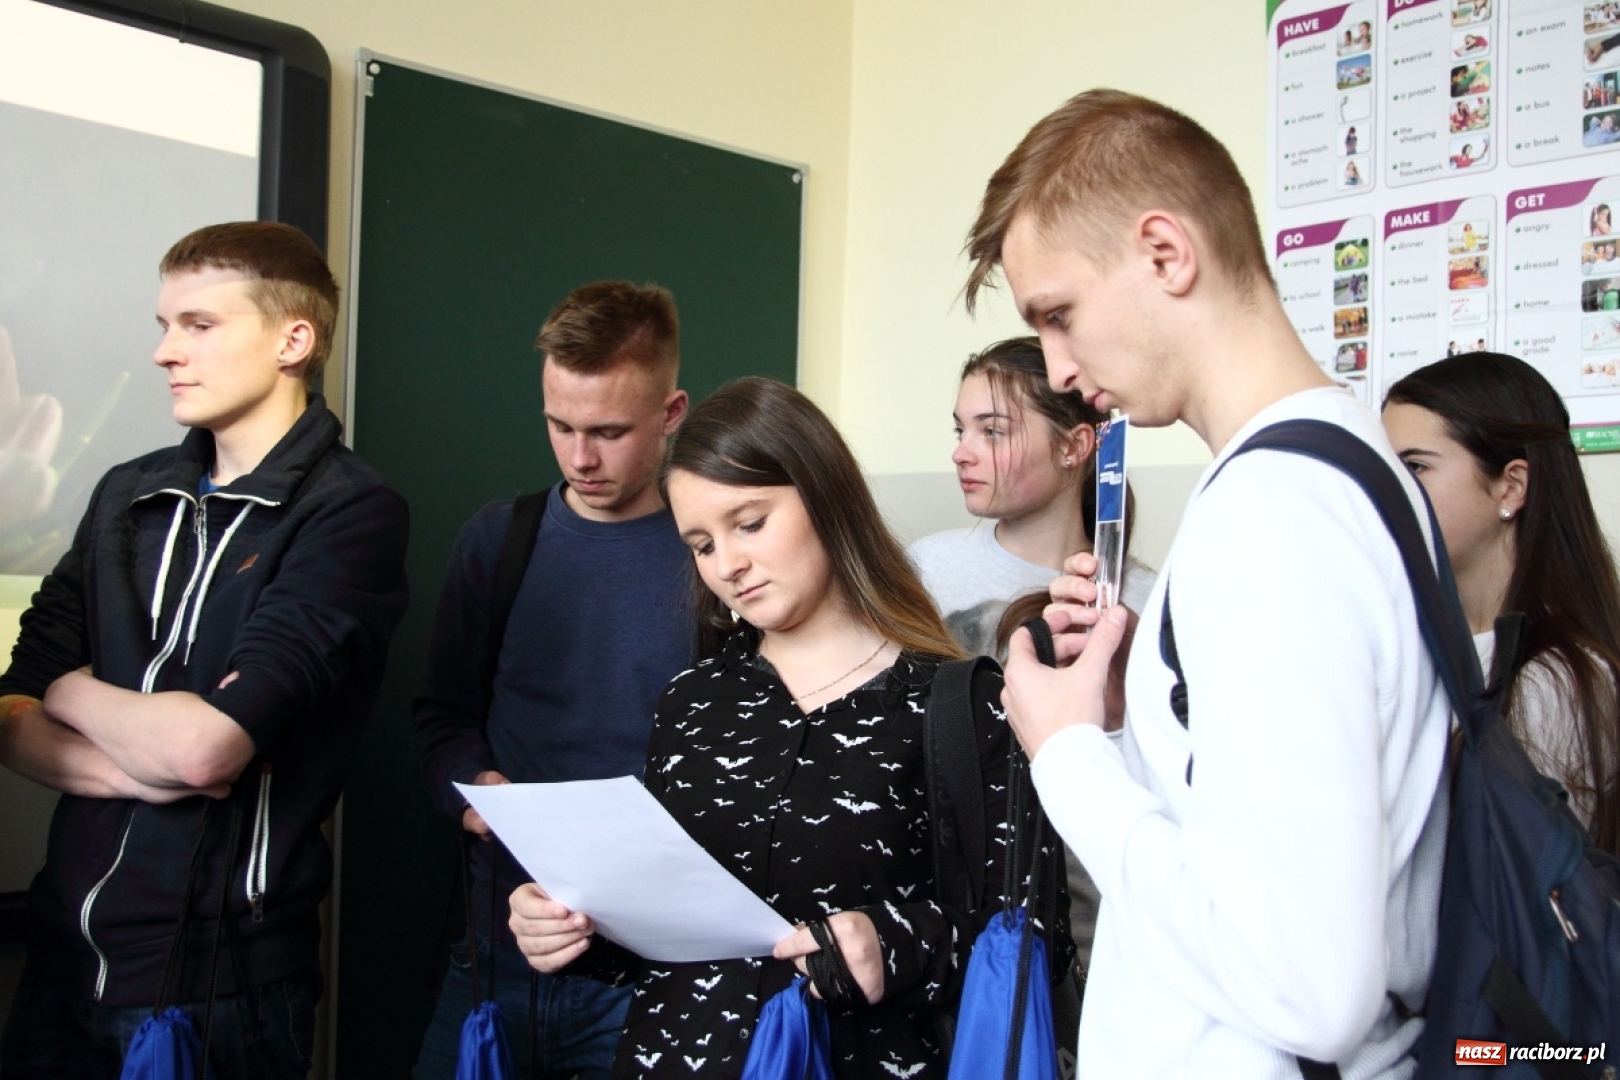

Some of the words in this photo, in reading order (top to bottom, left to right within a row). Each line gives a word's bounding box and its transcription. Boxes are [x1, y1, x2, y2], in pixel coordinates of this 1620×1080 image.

[1401, 11, 1443, 27] homework
[1284, 18, 1320, 37] HAVE
[1525, 27, 1538, 36] an
[1540, 21, 1567, 32] exam
[1401, 51, 1433, 63] exercise
[1525, 63, 1551, 73] notes
[1408, 85, 1436, 100] project
[1534, 100, 1551, 110] bus
[1400, 131, 1437, 144] shopping
[1533, 135, 1560, 147] break
[1399, 164, 1443, 177] housework
[1514, 193, 1546, 209] GET
[1390, 210, 1431, 229] MAKE
[1523, 223, 1551, 233] angry
[1283, 232, 1304, 247] GO
[1523, 257, 1559, 270] dressed
[1412, 273, 1428, 284] bed
[1523, 299, 1550, 307] home
[1406, 311, 1437, 321] mistake
[1531, 334, 1556, 346] good
[1522, 345, 1550, 356] grade
